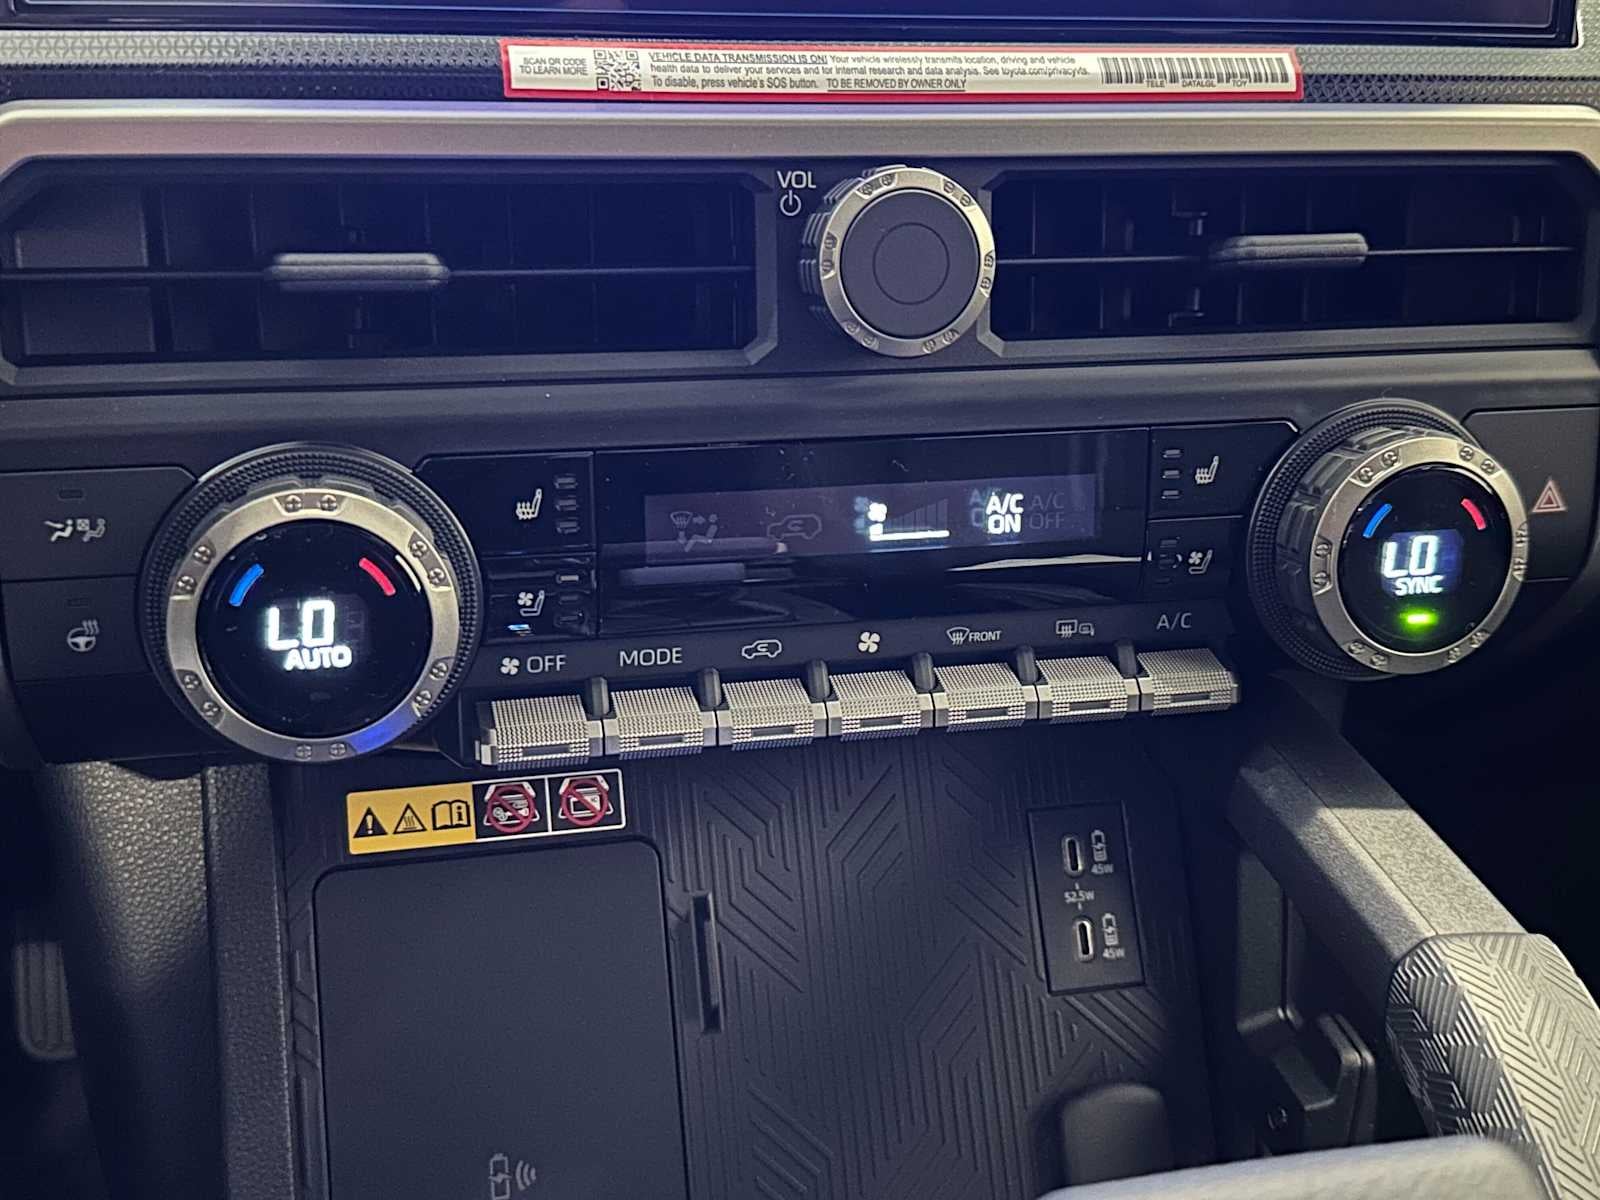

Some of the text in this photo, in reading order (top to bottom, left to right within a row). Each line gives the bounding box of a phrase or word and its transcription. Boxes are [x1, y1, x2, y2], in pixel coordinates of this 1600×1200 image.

[523, 57, 547, 65] SCAN
[562, 58, 587, 66] CODE
[648, 52, 691, 62] VEHICLE
[694, 53, 719, 63] DATA
[721, 53, 796, 64] TRANSMISSION
[798, 54, 808, 64] IS
[810, 54, 828, 64] ON!
[830, 55, 849, 63] Your
[851, 55, 880, 63] vehicle
[883, 56, 922, 65] wirelessly
[925, 56, 962, 64] transmits
[1000, 56, 1028, 66] driving
[1030, 56, 1045, 64] and
[1047, 56, 1076, 64] vehicle
[519, 65, 588, 76] TO LEARN MORE
[650, 63, 678, 73] health
[680, 64, 699, 73] data
[702, 65, 711, 73] to
[713, 65, 741, 74] deliver
[744, 66, 763, 76] your
[766, 66, 801, 75] services
[803, 66, 819, 75] and
[821, 66, 833, 74] for
[835, 66, 867, 75] internal
[868, 66, 905, 76] research
[907, 66, 922, 75] and
[925, 66, 943, 75] data
[983, 66, 999, 75] See
[651, 75, 818, 89] To disable, press vehicle's SOS button.
[826, 78, 967, 89] TO BE REMOVED BY OWNER ONLY
[1145, 80, 1165, 88] TELE
[1231, 80, 1247, 88] TOY
[776, 170, 817, 189] VOL
[985, 491, 1024, 515] A/C
[1031, 490, 1065, 511] A/C
[988, 514, 1022, 534] ON
[1029, 511, 1065, 530] OFF
[1394, 574, 1445, 596] SYNC
[1156, 612, 1192, 630] A/C
[968, 630, 1002, 642] FRONT
[283, 645, 352, 671] AUTO
[526, 655, 567, 673] OFF
[619, 647, 683, 667] MODE
[1091, 863, 1115, 875] 45W
[1063, 890, 1095, 904] 52.5W
[1102, 948, 1126, 959] 45W
